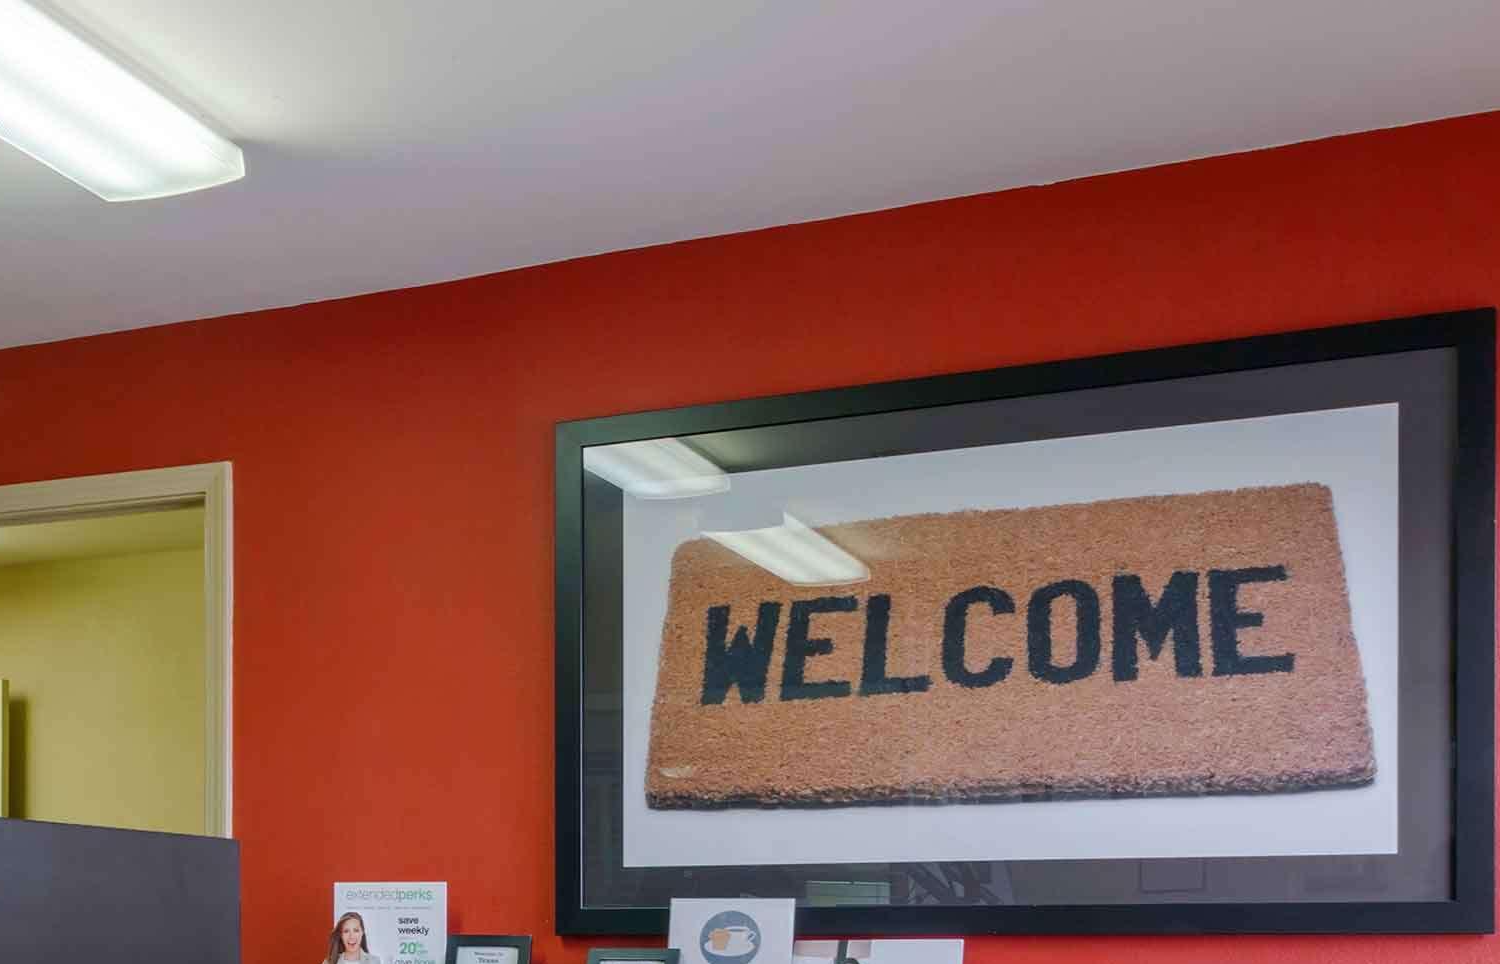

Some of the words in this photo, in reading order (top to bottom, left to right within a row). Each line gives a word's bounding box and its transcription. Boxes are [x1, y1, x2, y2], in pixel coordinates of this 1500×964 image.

[701, 564, 1294, 705] WELCOME
[398, 917, 419, 925] save
[398, 926, 429, 936] weekly
